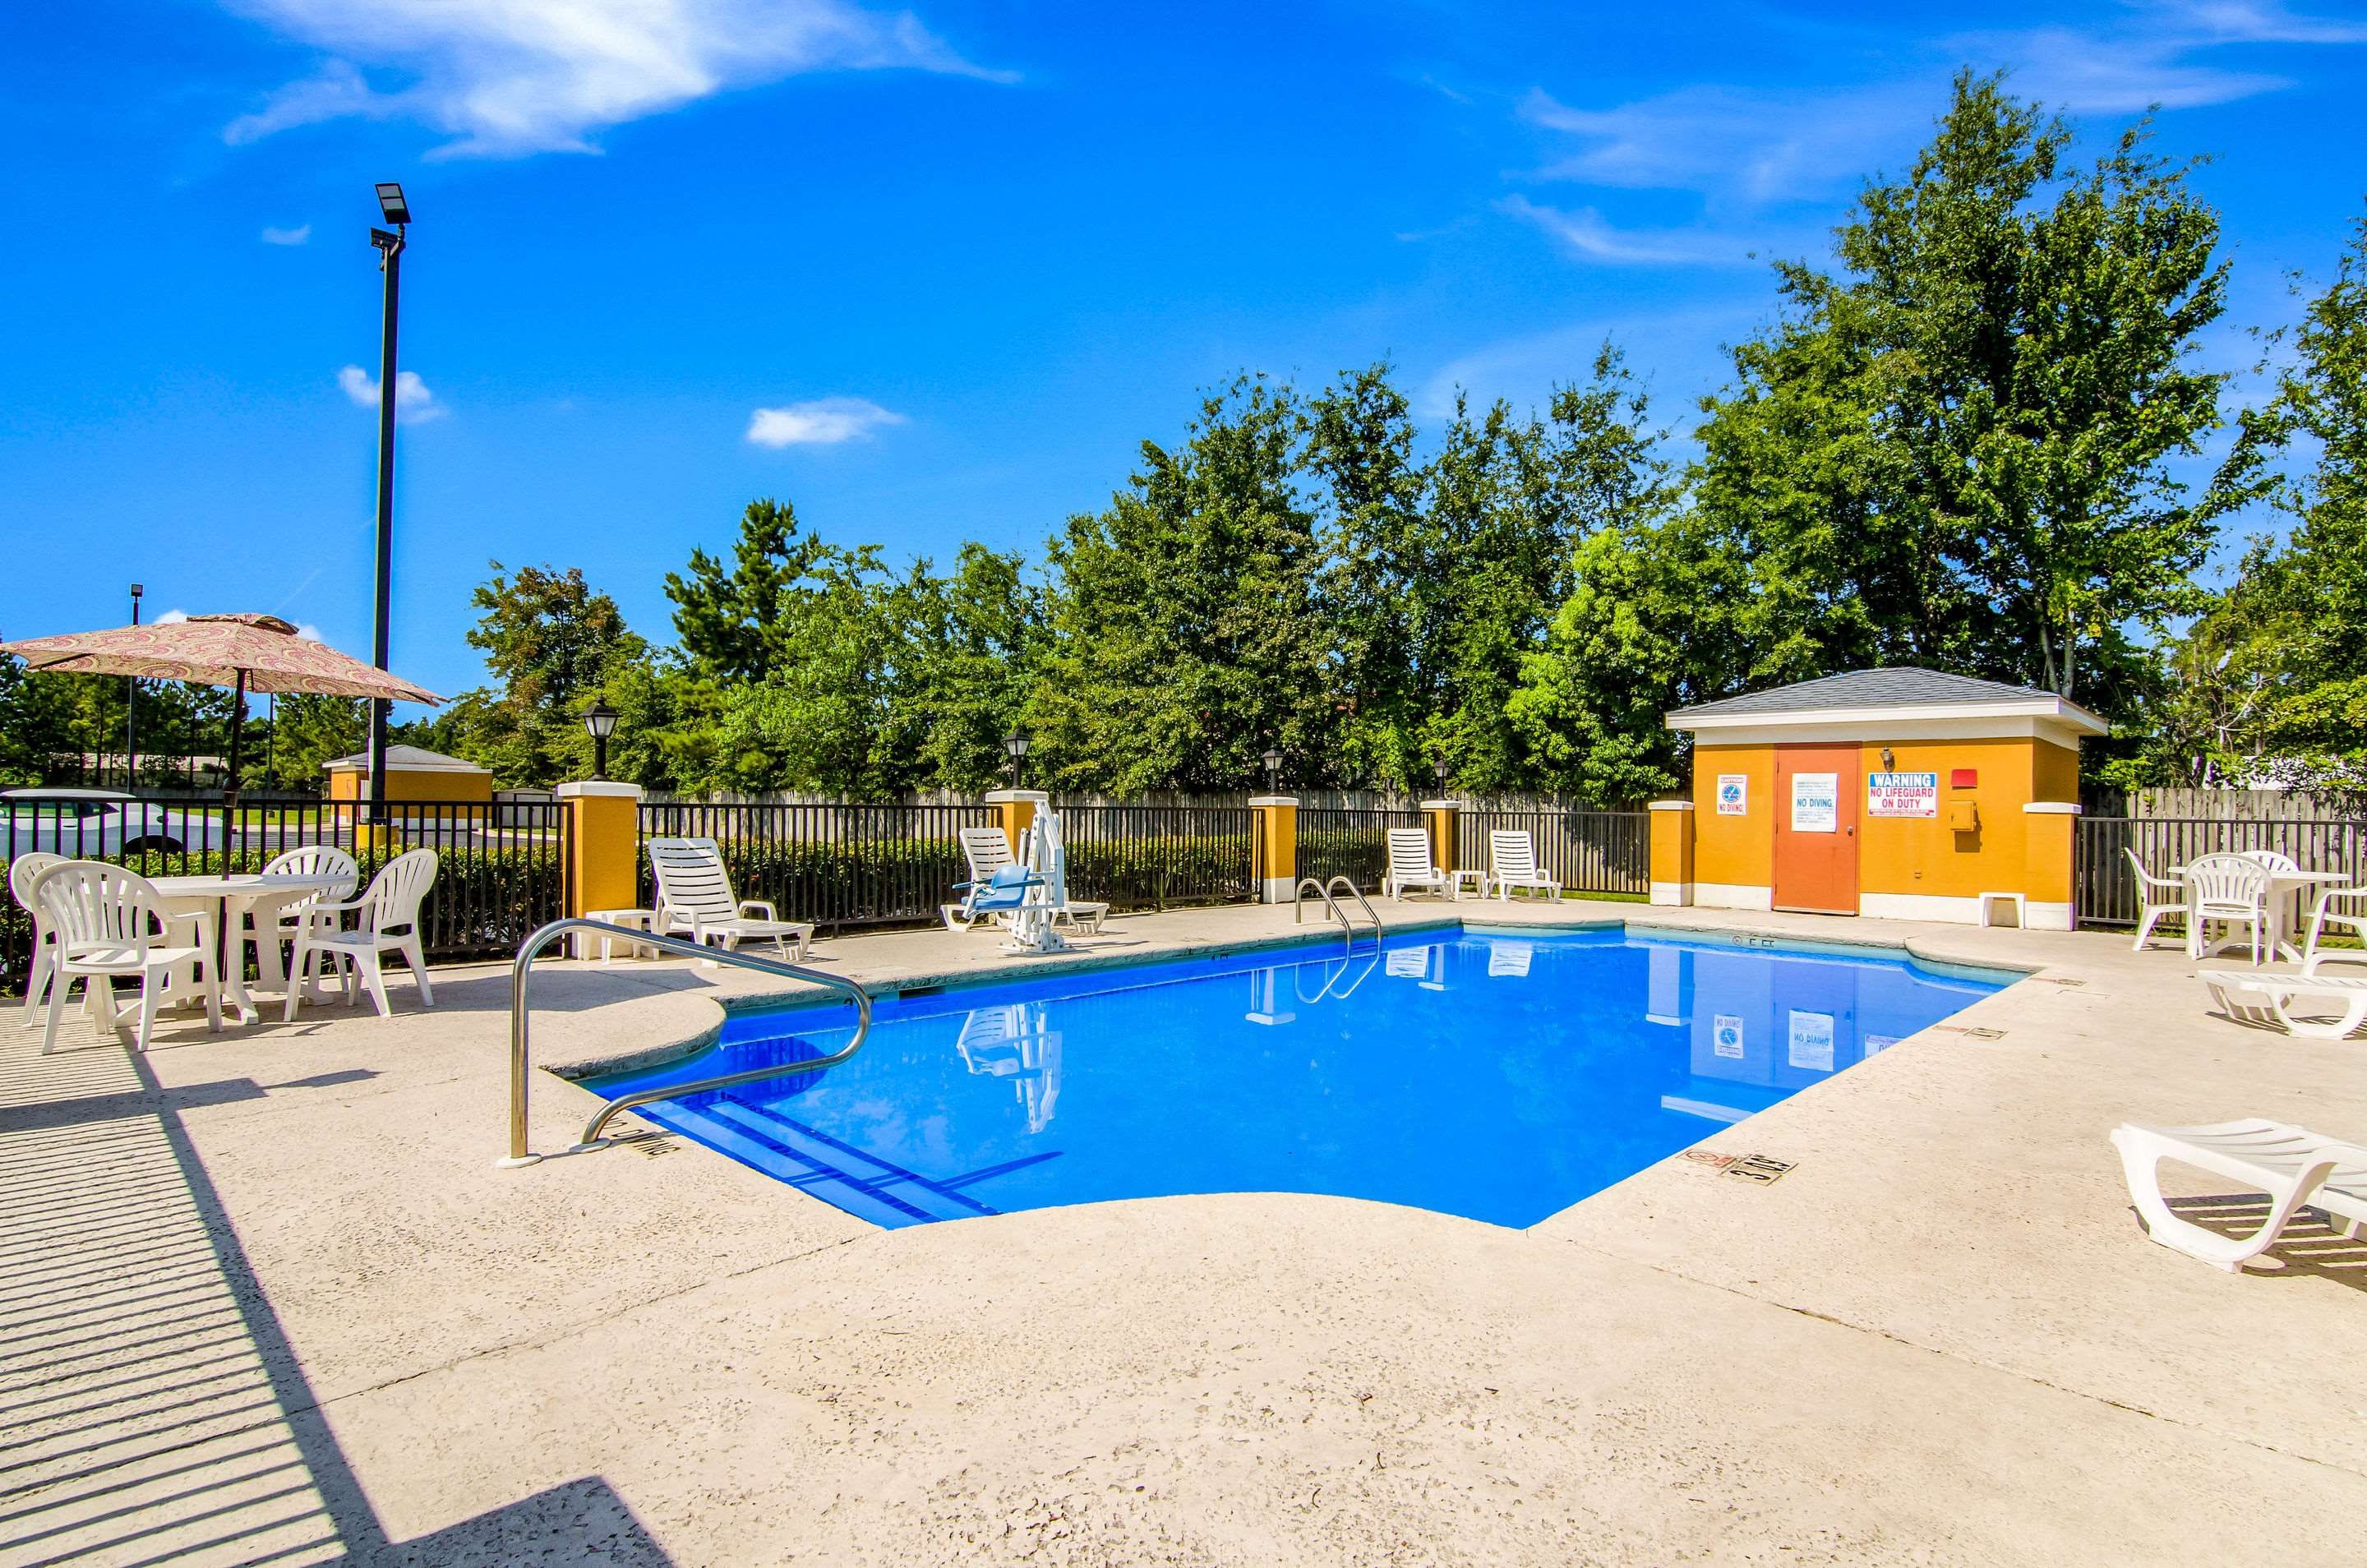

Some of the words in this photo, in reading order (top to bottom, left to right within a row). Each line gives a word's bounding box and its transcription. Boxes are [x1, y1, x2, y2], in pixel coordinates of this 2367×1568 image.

[1874, 774, 1931, 786] WARNING
[1870, 788, 1882, 797] NO
[1885, 788, 1933, 798] LIFEGUARD
[1719, 804, 1726, 812] NO
[1727, 804, 1743, 812] DIVING
[1797, 798, 1807, 808] NO
[1809, 798, 1833, 808] DIVING
[1882, 799, 1894, 808] ON
[1898, 799, 1921, 808] DUTY
